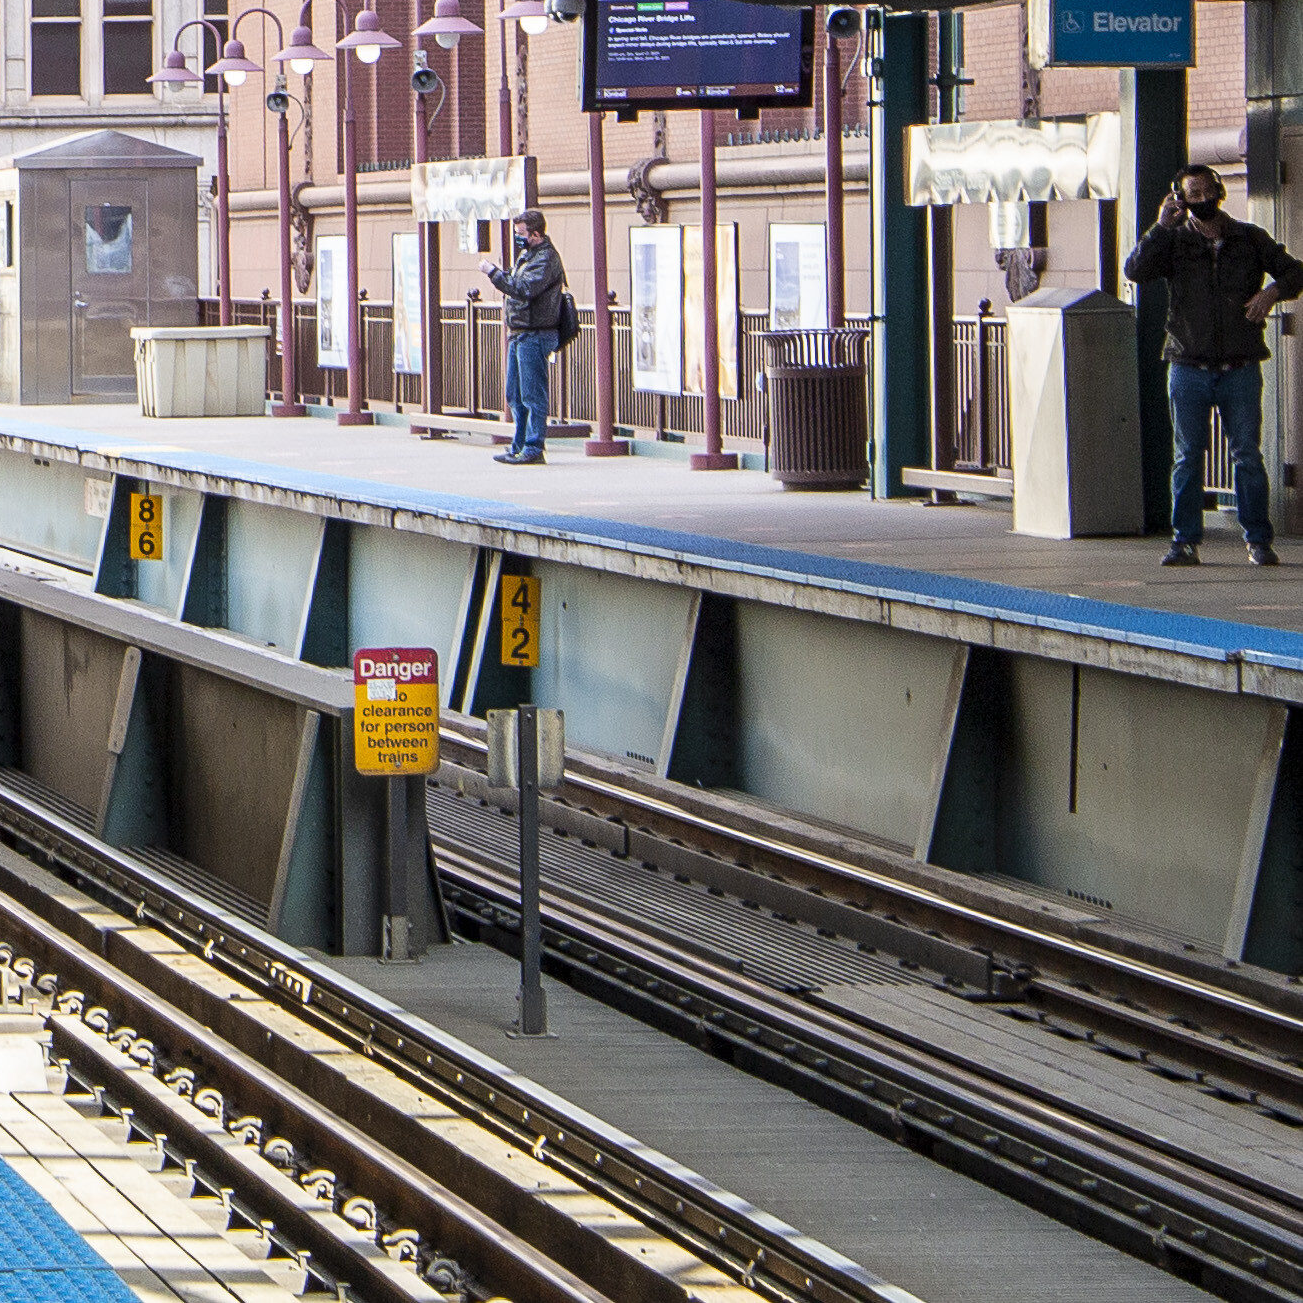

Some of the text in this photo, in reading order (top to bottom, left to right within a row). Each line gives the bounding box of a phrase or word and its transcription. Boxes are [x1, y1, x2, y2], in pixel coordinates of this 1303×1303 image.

[1094, 12, 1182, 32] Elevator
[360, 659, 432, 681] Danger
[363, 705, 432, 716] clearance
[361, 721, 434, 735] for person
[368, 737, 428, 748] between
[378, 751, 417, 763] trains
